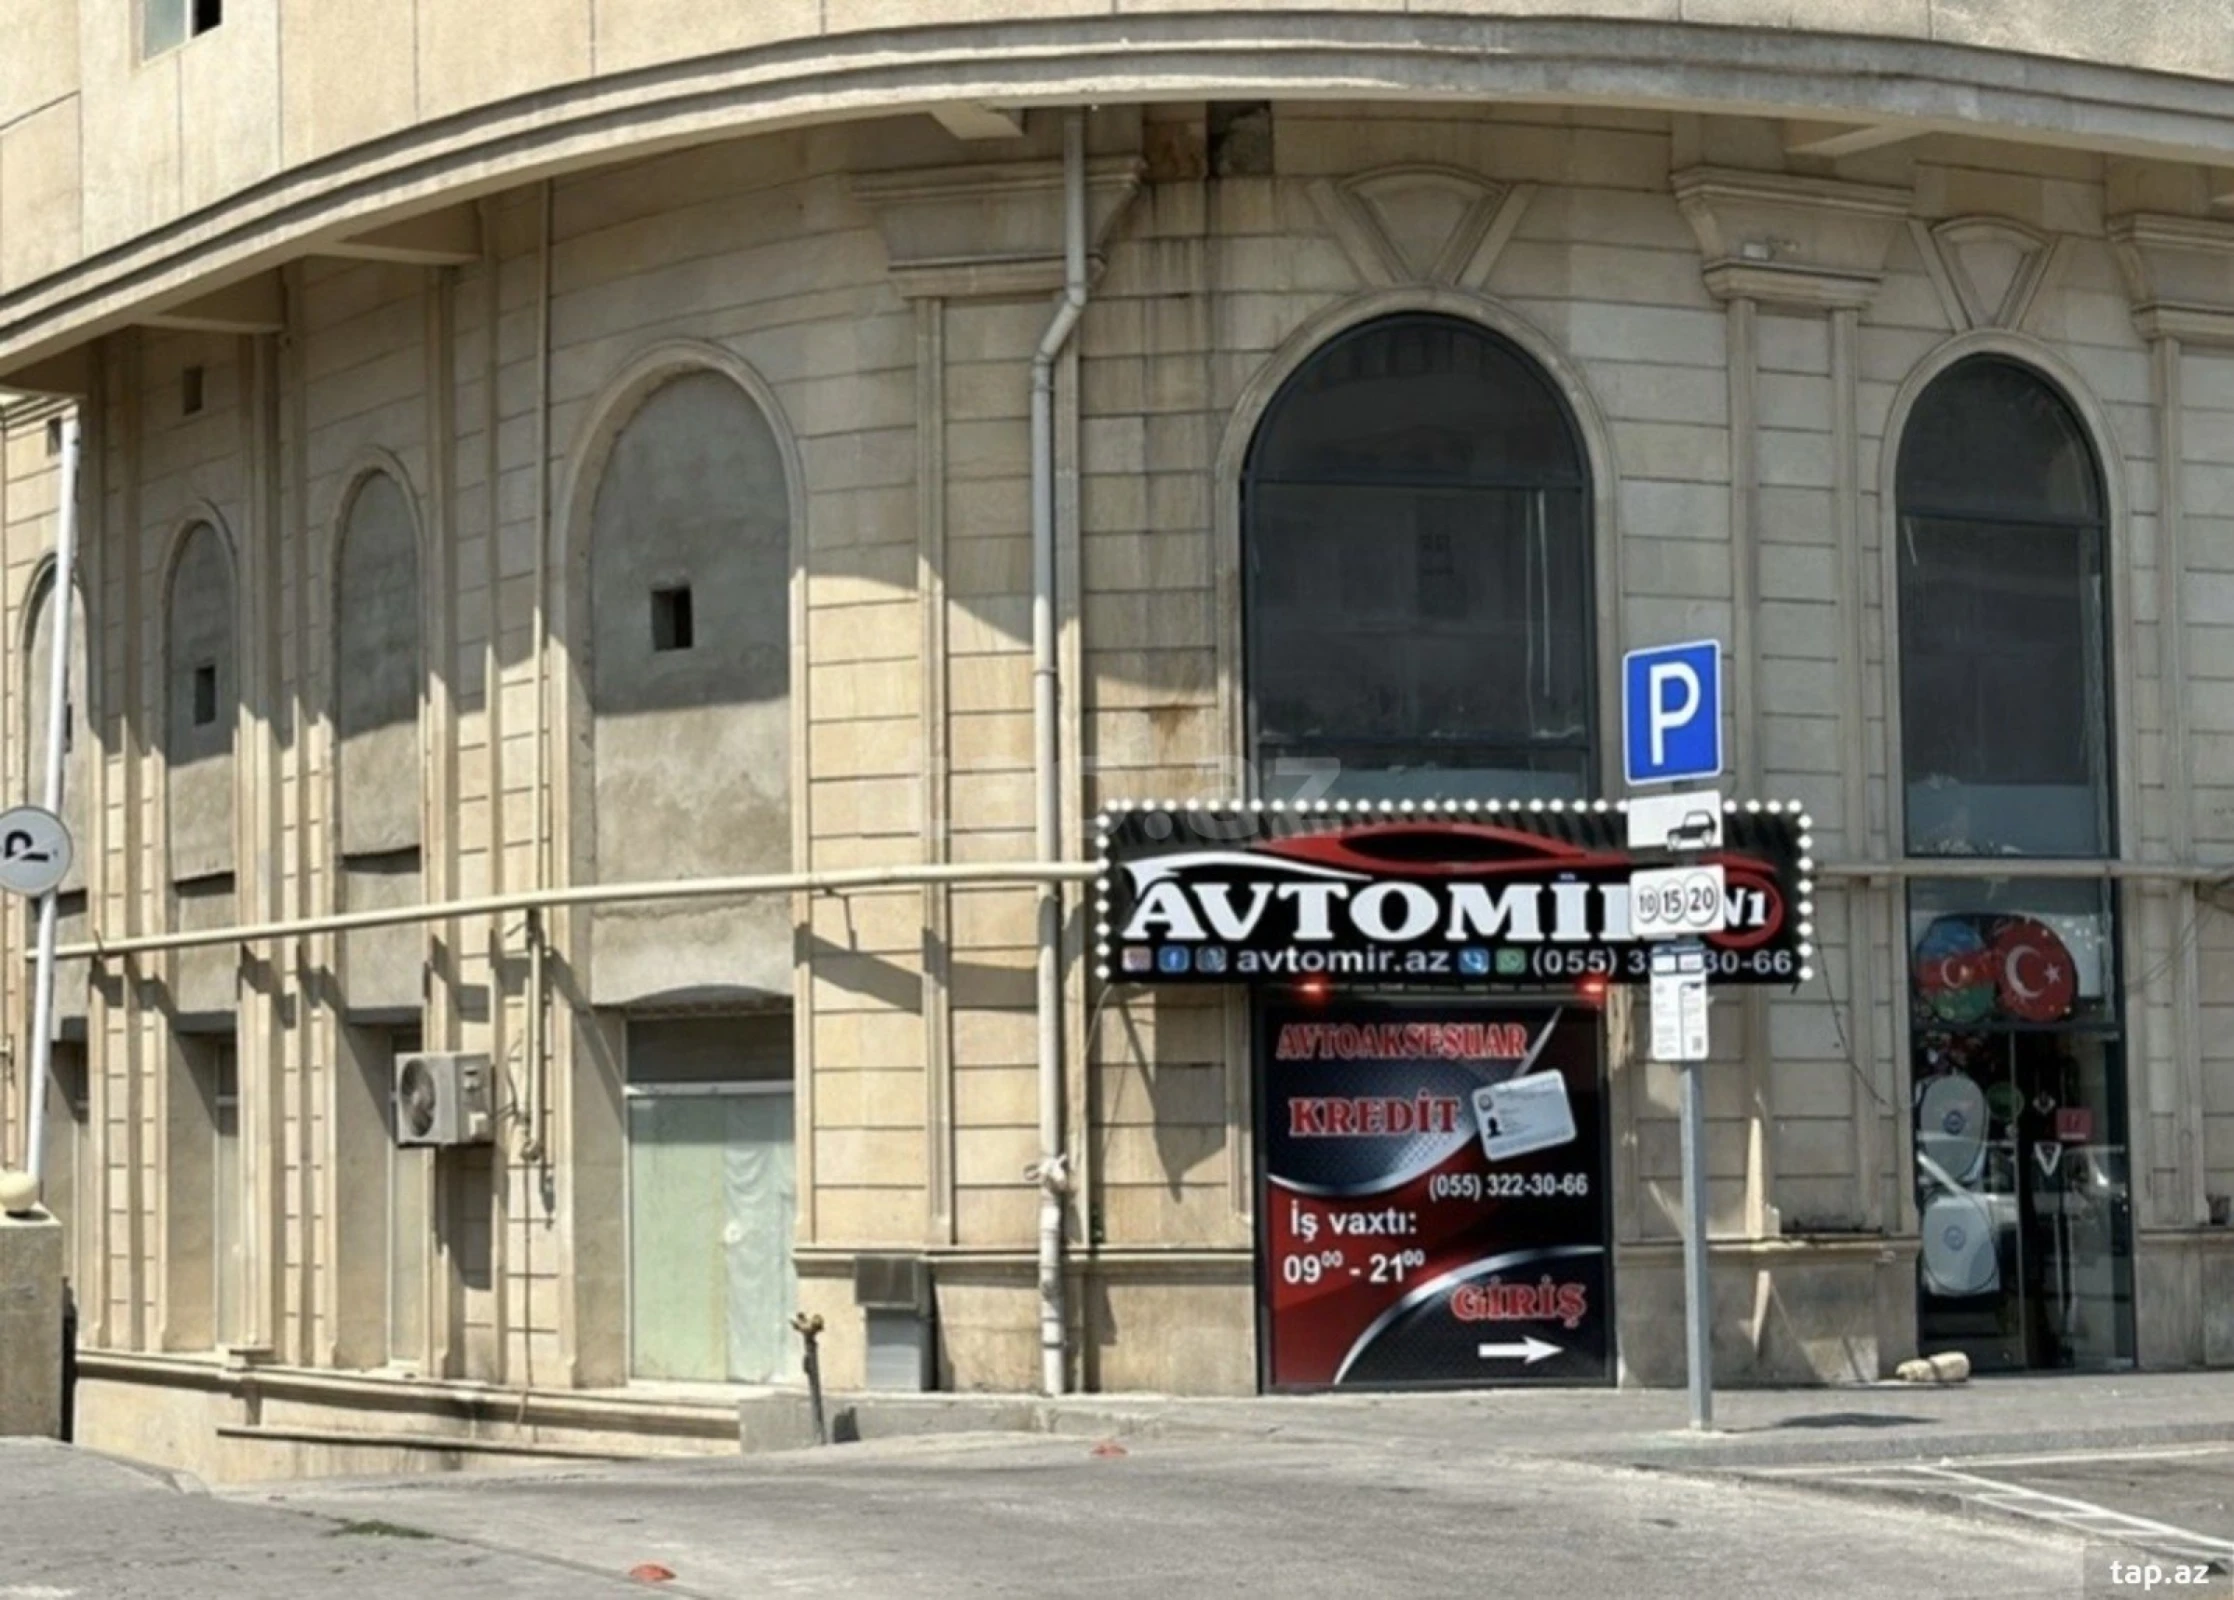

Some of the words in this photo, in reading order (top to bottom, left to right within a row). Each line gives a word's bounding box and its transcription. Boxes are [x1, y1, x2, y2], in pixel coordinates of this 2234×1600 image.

[1649, 661, 1701, 766] P
[1663, 888, 1682, 914] 15
[1690, 885, 1714, 912] 20
[1237, 945, 1450, 973] avtomir.az
[1532, 946, 1617, 977] (055)
[1289, 1088, 1463, 1137] KREDİT
[1429, 1173, 1481, 1201] (055)
[1487, 1173, 1588, 1197] 322-30-66
[1290, 1199, 1318, 1243] İş
[1327, 1206, 1417, 1235] vaxtı:
[1451, 1275, 1587, 1328] GİRİŞ
